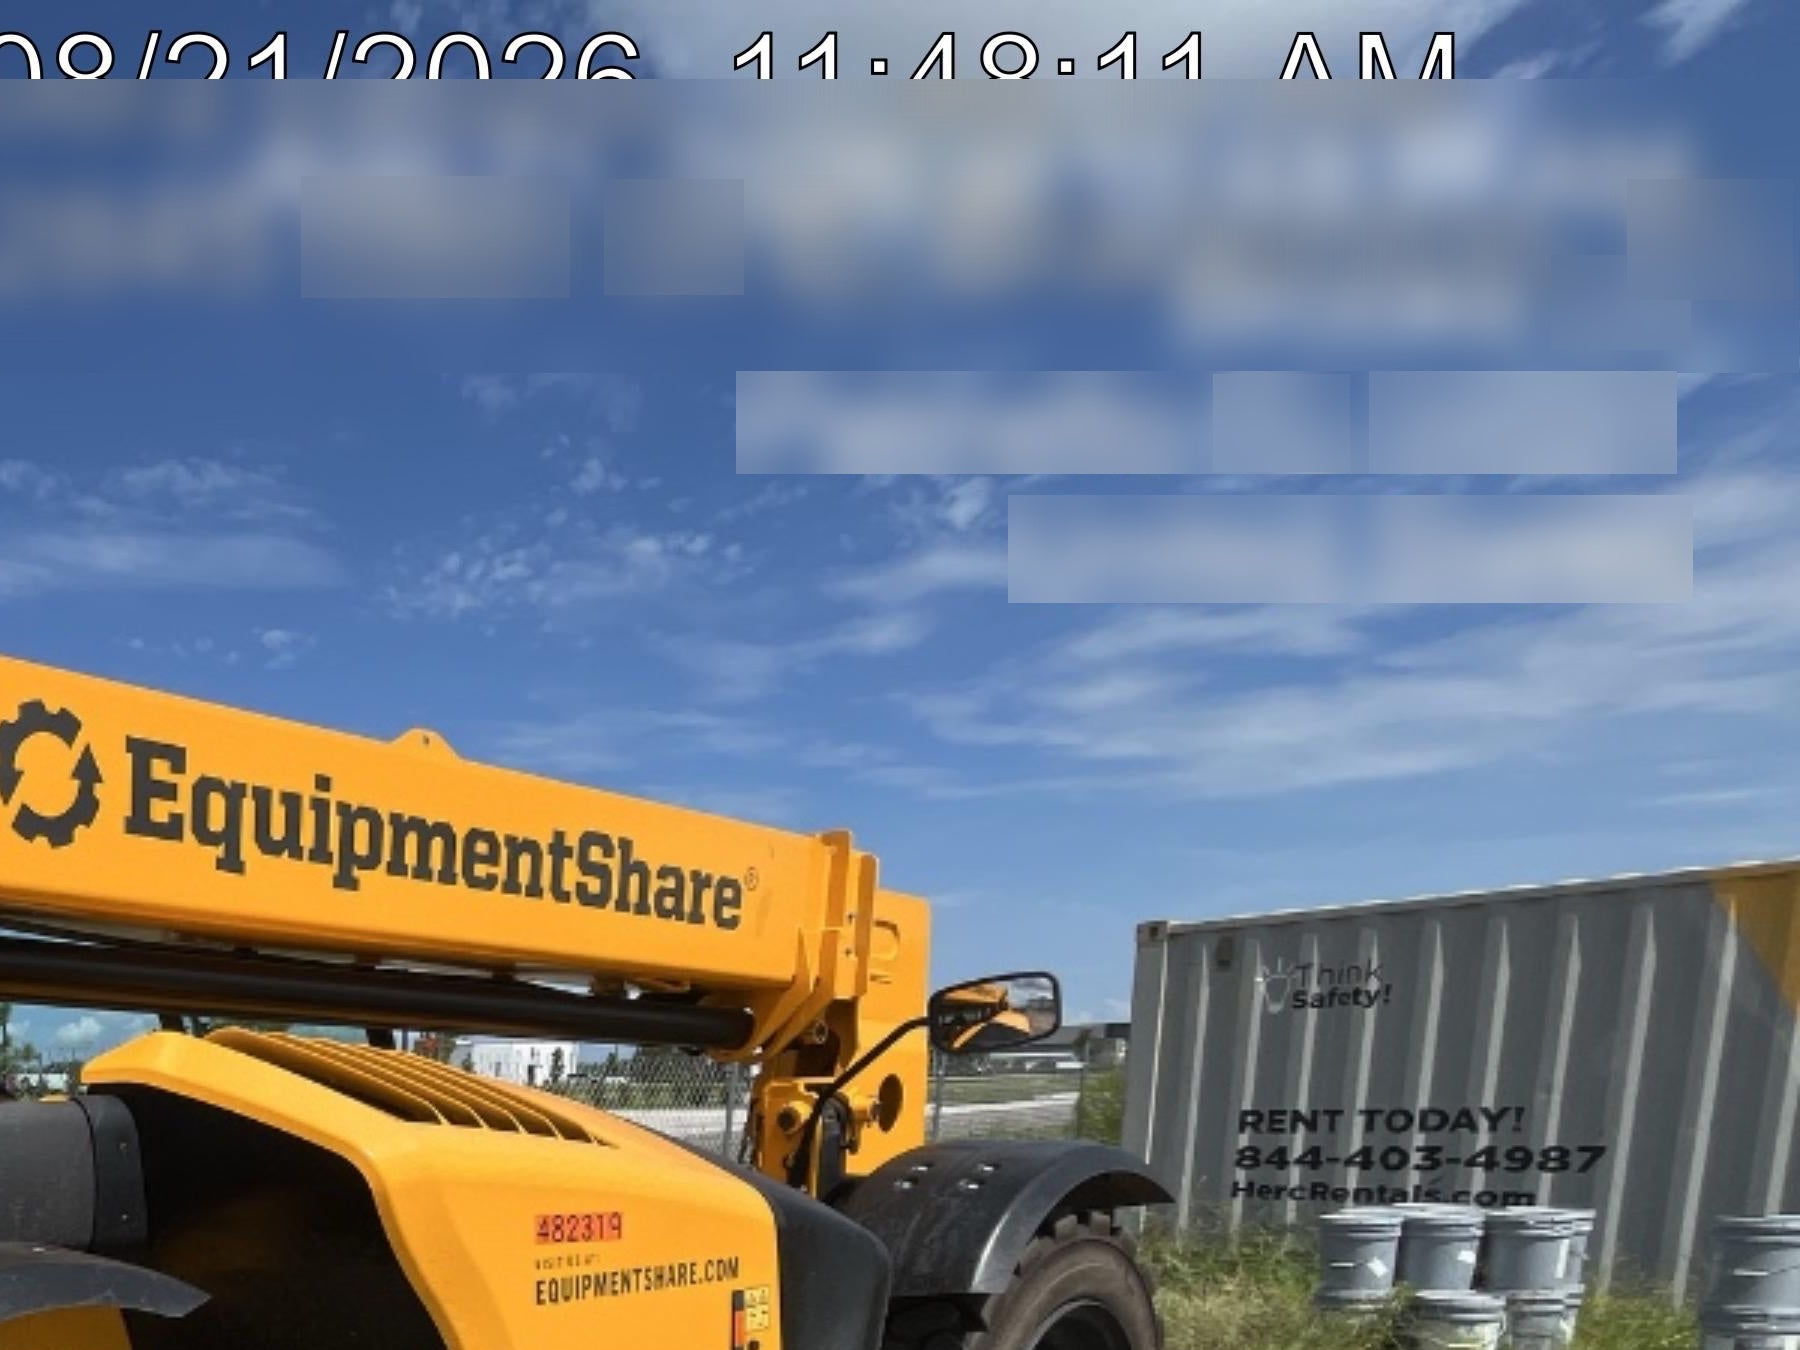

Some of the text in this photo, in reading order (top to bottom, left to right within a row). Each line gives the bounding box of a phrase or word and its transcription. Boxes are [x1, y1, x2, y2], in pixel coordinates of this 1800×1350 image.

[1295, 957, 1383, 987] Think
[1292, 983, 1392, 1009] Safety!
[1238, 1106, 1525, 1134] RENT TODAY!
[1234, 1145, 1607, 1174] 844-403-4987
[536, 1211, 622, 1243] 482319
[536, 1256, 740, 1305] EQUIPMENTSHARE.COM
